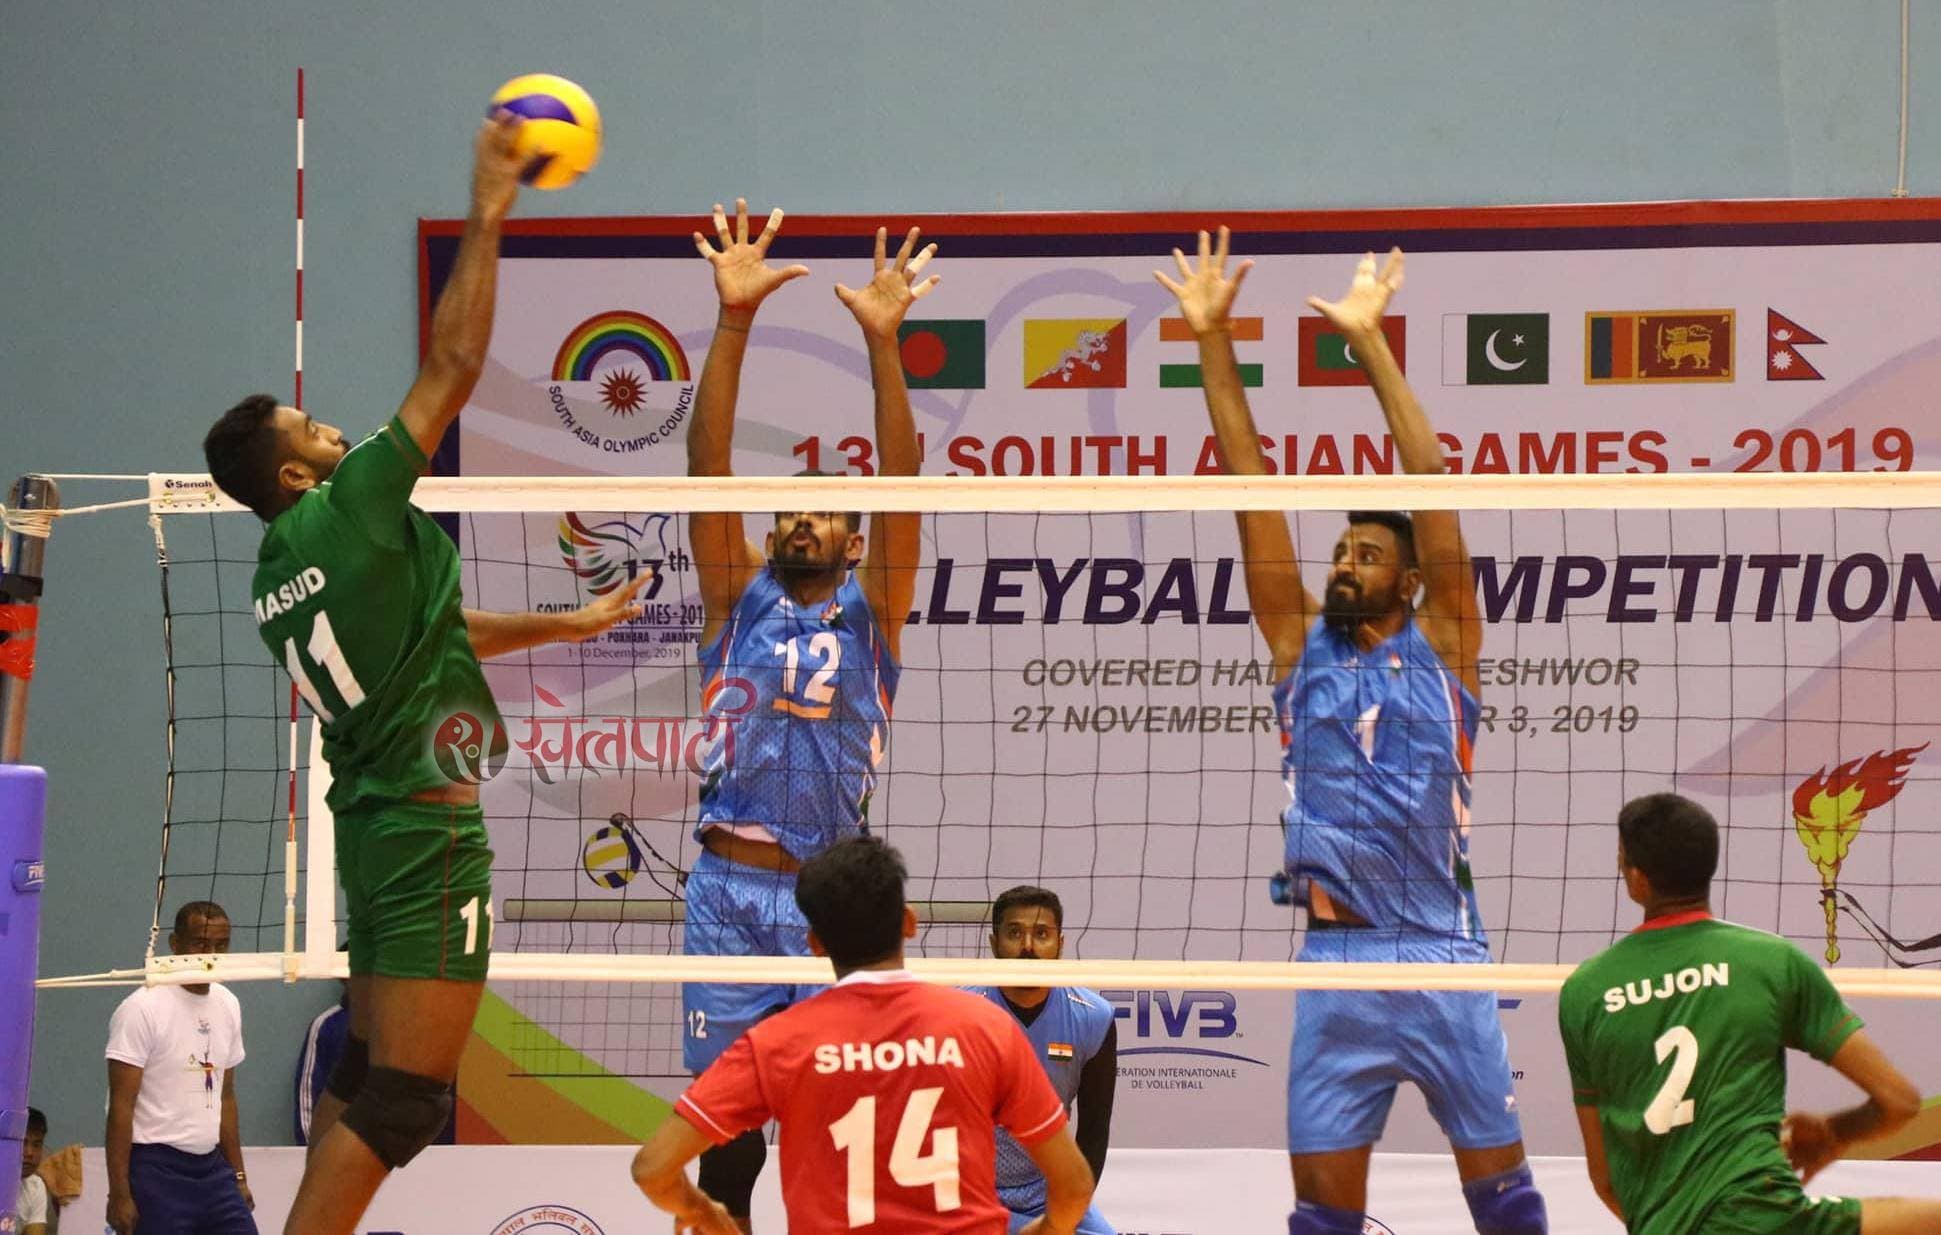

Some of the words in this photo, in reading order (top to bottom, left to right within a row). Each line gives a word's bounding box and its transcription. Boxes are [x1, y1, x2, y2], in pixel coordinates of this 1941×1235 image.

[549, 385, 576, 428] SOUTH
[572, 426, 600, 448] ASIA
[603, 432, 659, 453] OLYMPIC
[659, 384, 694, 437] COUNCIL
[946, 435, 1168, 476] SOUTH
[1732, 427, 1914, 473] 2019
[905, 558, 1251, 625] LEYBAL
[285, 610, 366, 725] 11
[654, 647, 681, 659] 2019
[774, 631, 841, 704] 12
[1022, 658, 1201, 687] COVERED
[1011, 705, 1055, 733] 27
[1508, 705, 1538, 738] 3,
[1551, 705, 1641, 733] 2019
[1354, 704, 1382, 764] 1
[1603, 962, 1730, 1013] SUJON
[687, 1009, 707, 1039] 12
[814, 1035, 965, 1074] SHONA
[1157, 1067, 1237, 1079] INTERNATIONALE
[1131, 1080, 1145, 1090] DE
[1147, 1080, 1204, 1090] VOLLEYBALL
[1644, 1025, 1699, 1135] 2
[828, 1086, 962, 1229] 14
